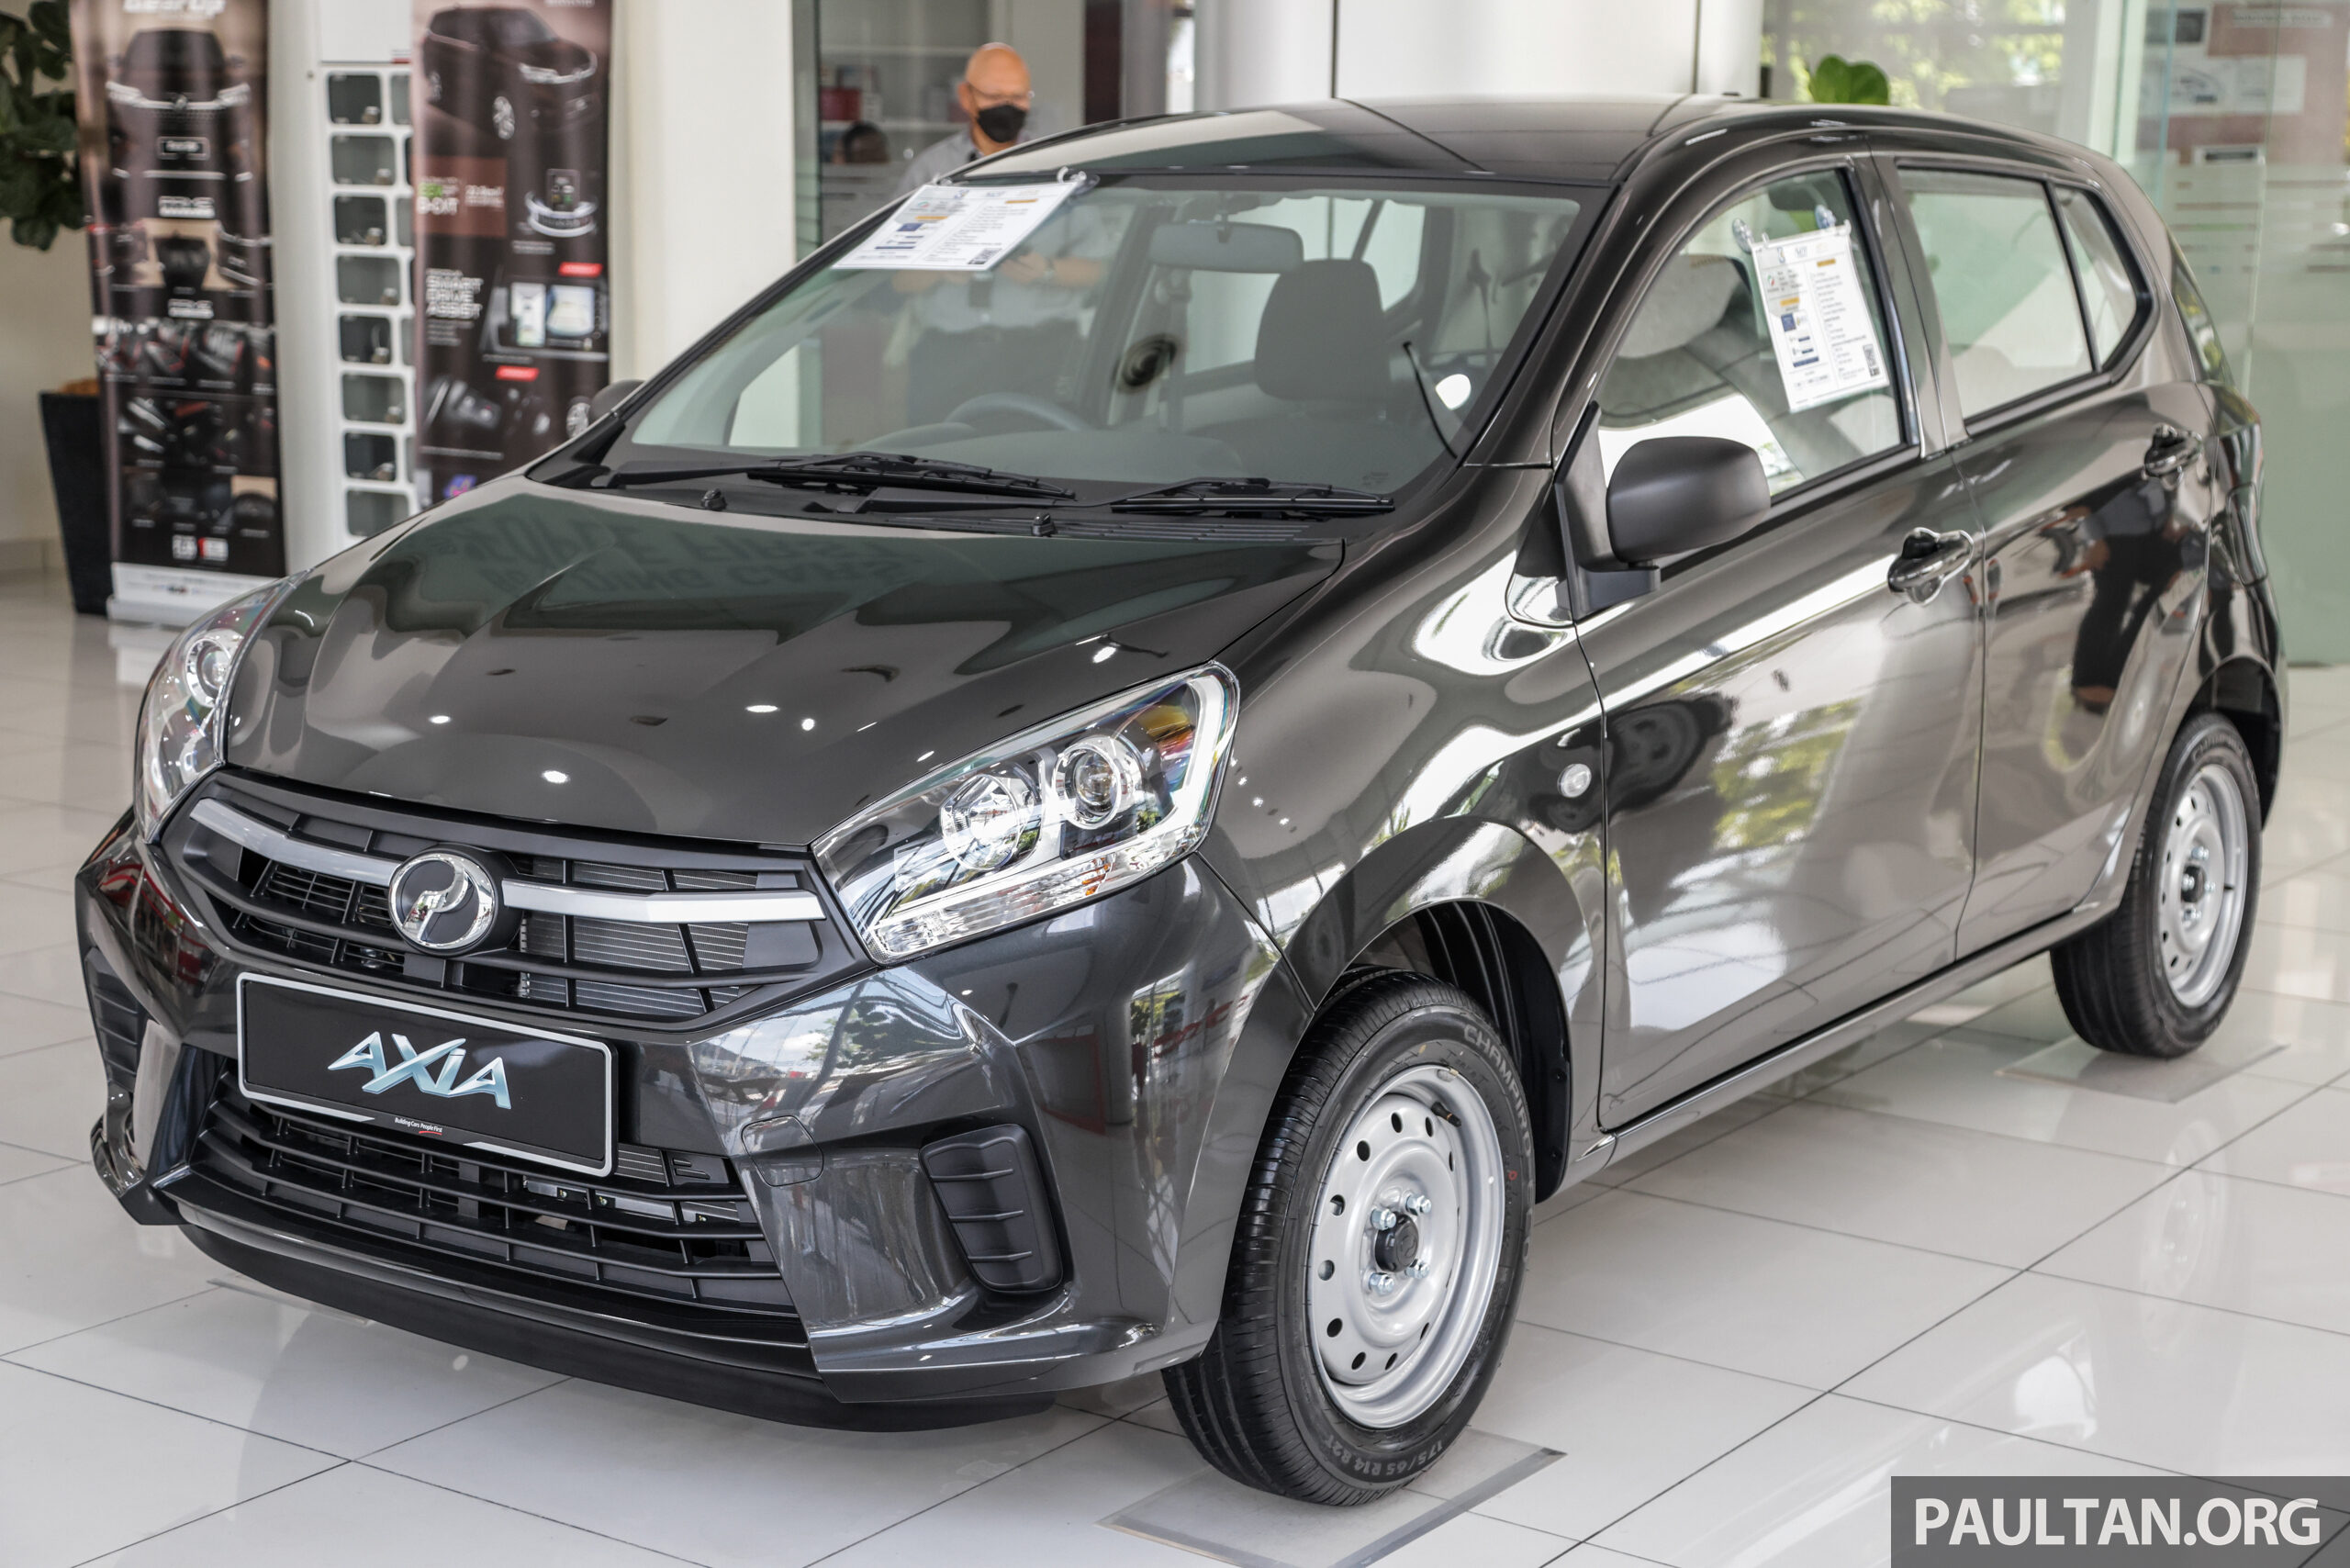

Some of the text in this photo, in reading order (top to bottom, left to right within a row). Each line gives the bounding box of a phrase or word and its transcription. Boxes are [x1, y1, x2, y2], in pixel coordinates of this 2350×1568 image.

[327, 1030, 512, 1110] AXIA
[1463, 1024, 1533, 1158] CHAMPIRO
[395, 1117, 410, 1126] Building
[420, 1123, 433, 1131] People
[1324, 1434, 1444, 1476] 175/65 R14 82T
